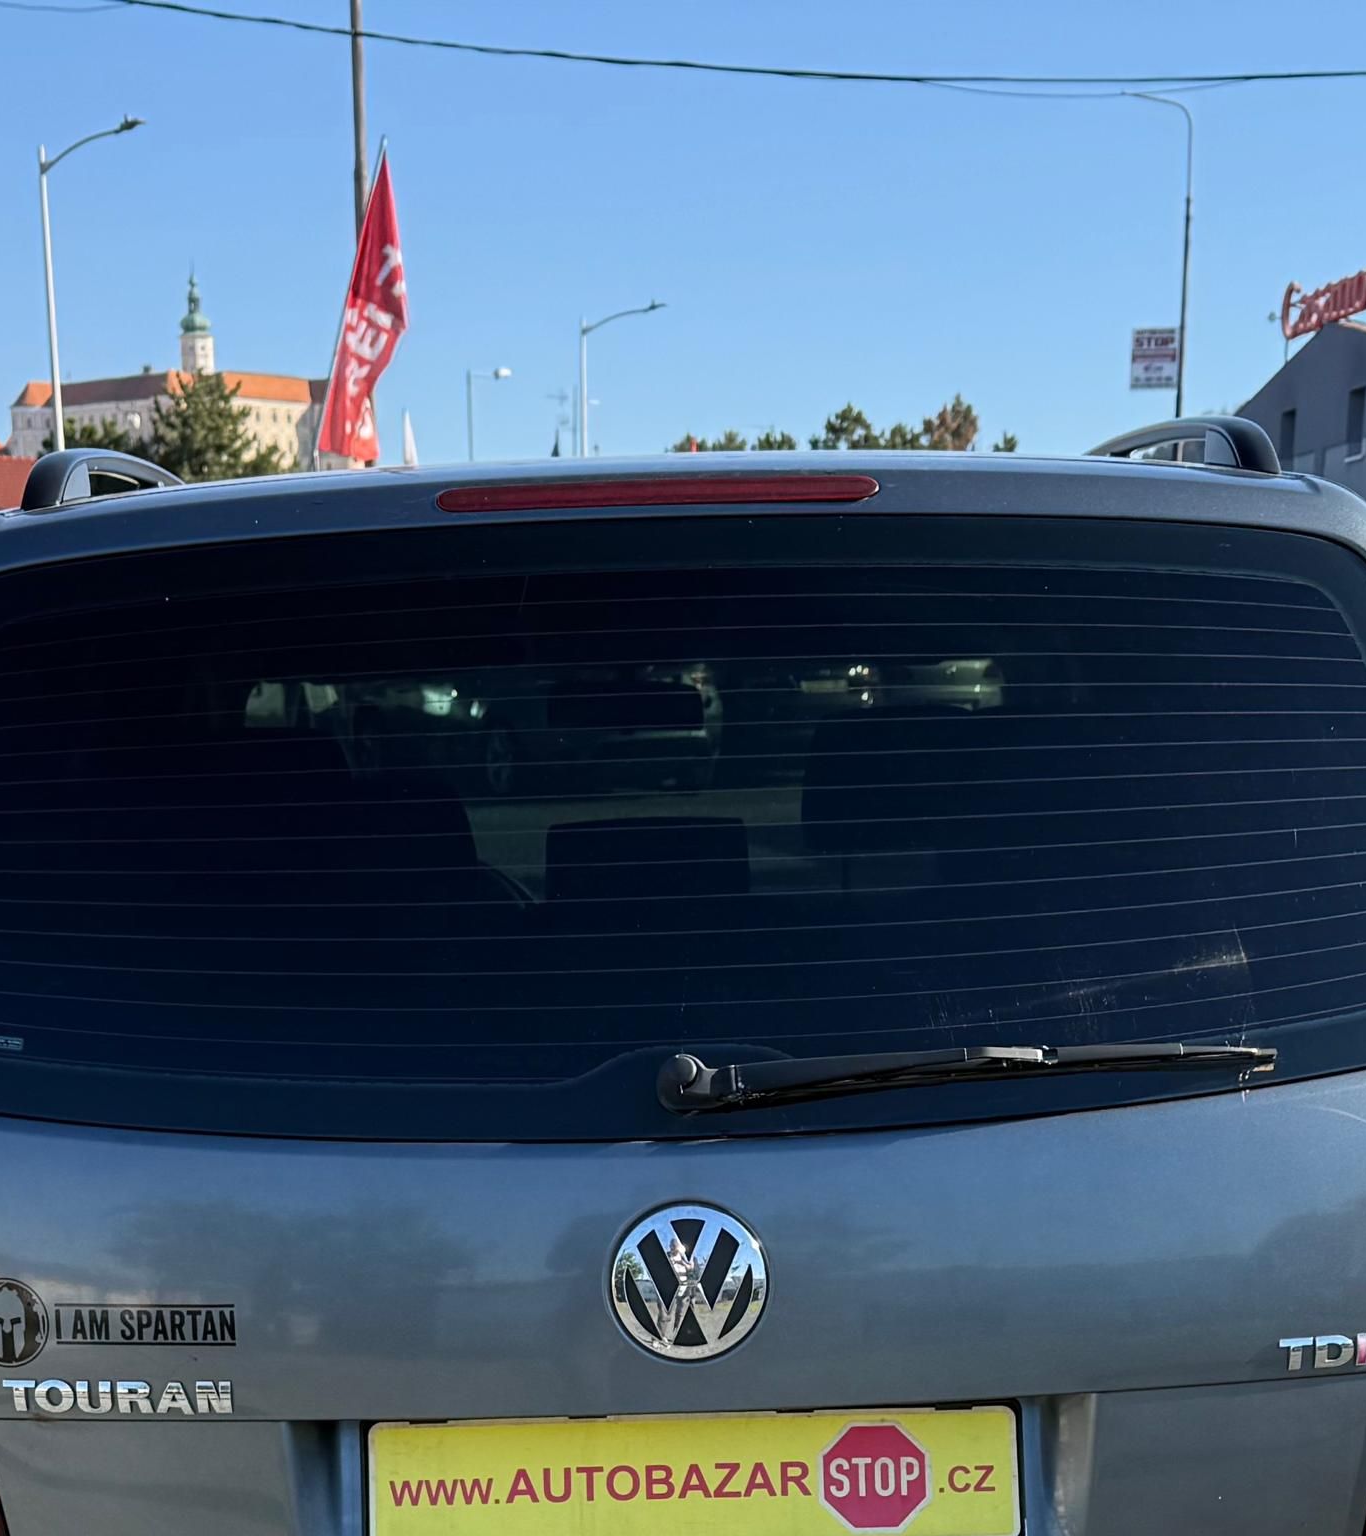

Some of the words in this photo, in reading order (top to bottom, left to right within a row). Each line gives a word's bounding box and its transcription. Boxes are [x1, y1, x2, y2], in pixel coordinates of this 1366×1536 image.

[54, 1308, 62, 1340] I
[71, 1309, 111, 1341] AM
[120, 1309, 236, 1342] SPARTAN
[2, 1378, 235, 1416] TOURAN
[828, 1456, 921, 1499] STOP
